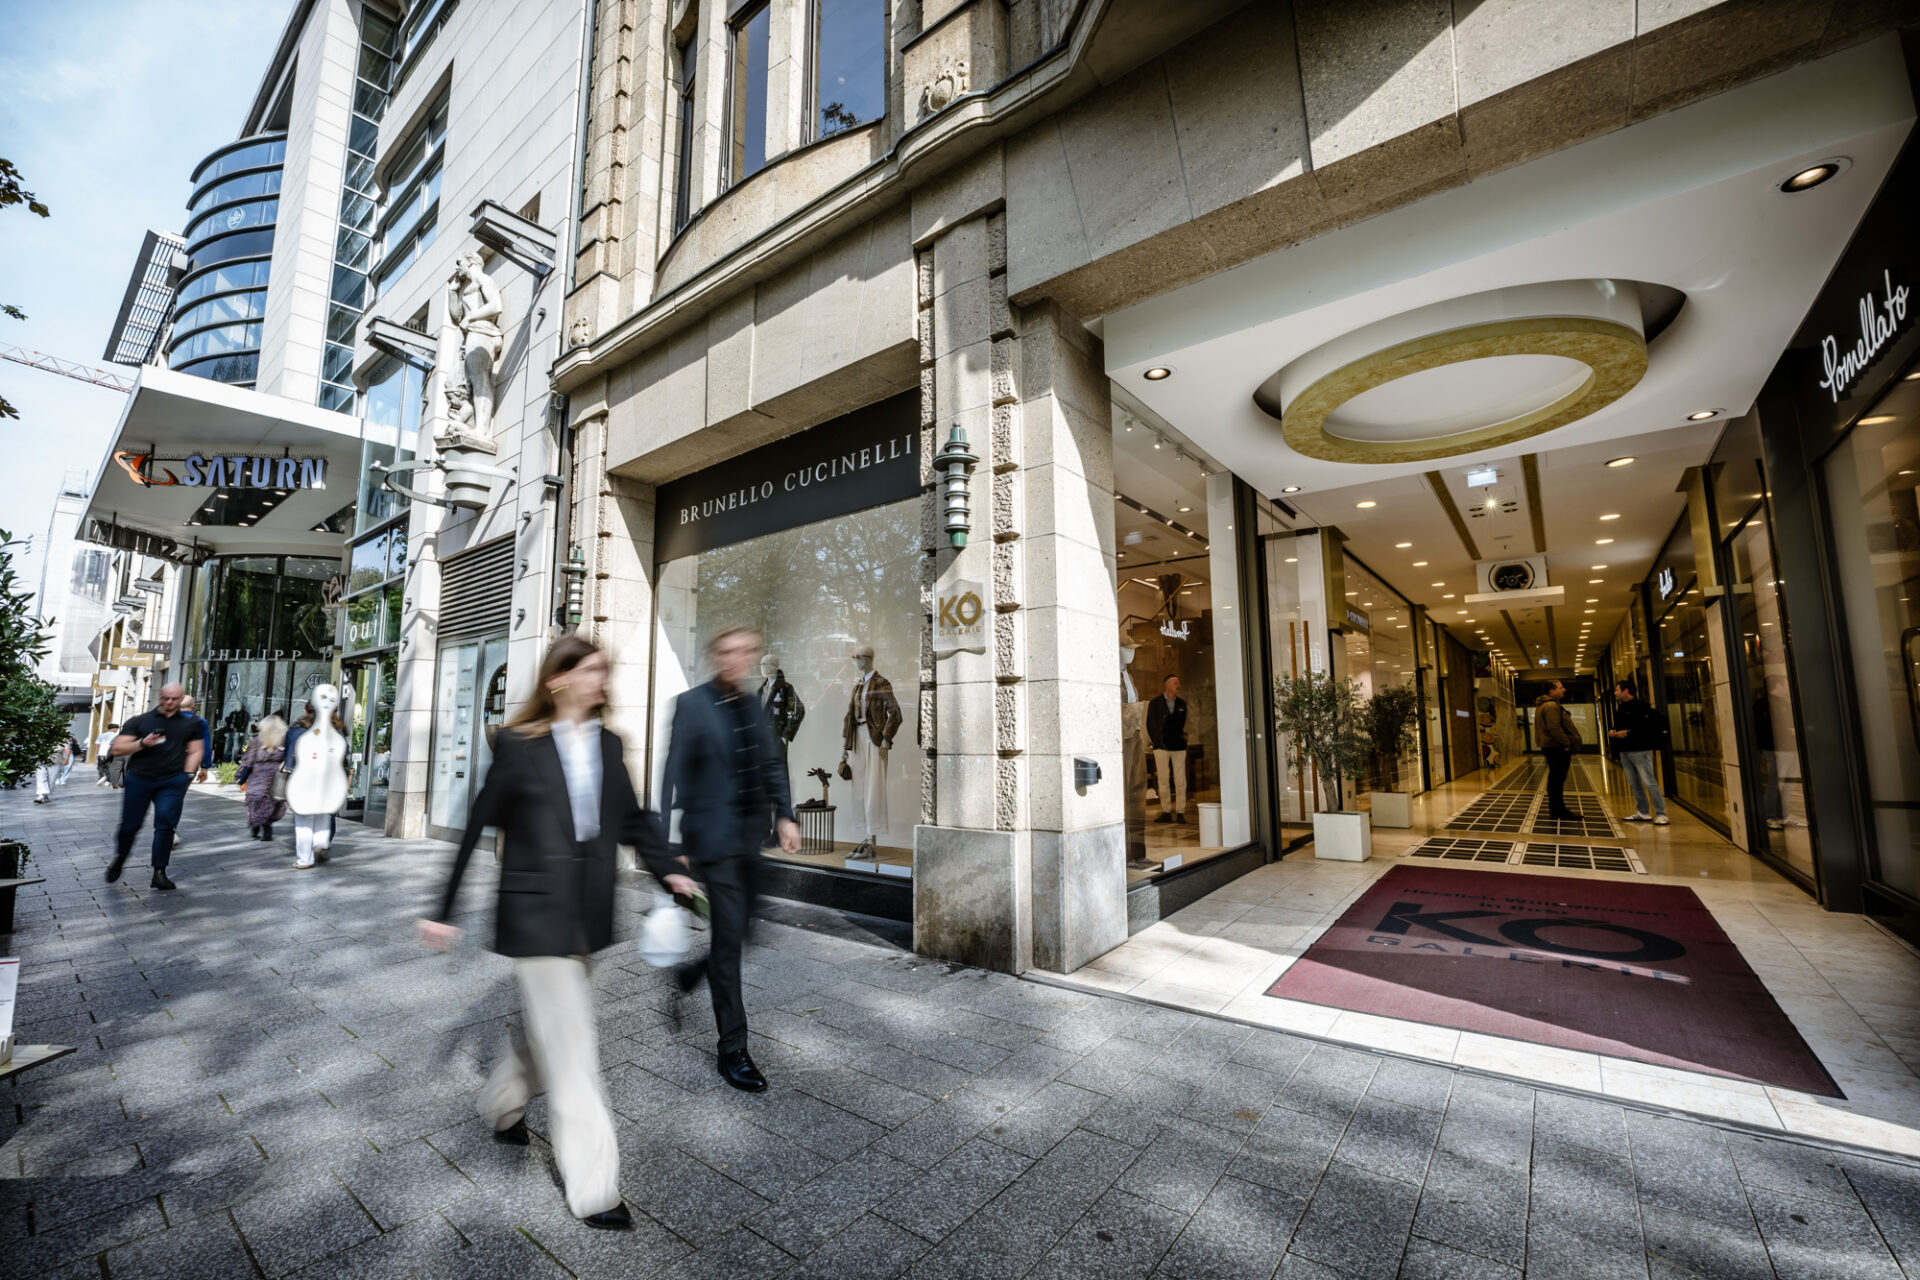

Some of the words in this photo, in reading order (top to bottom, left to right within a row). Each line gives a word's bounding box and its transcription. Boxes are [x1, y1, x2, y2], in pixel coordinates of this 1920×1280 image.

[1819, 269, 1909, 403] Pomellato
[183, 454, 327, 489] SATURN
[679, 480, 774, 525] BRUNELLO
[783, 434, 913, 491] CUCINELLI
[938, 625, 982, 637] GALERIE
[207, 648, 302, 661] PHILIPP
[1366, 935, 1695, 984] GALERIE
